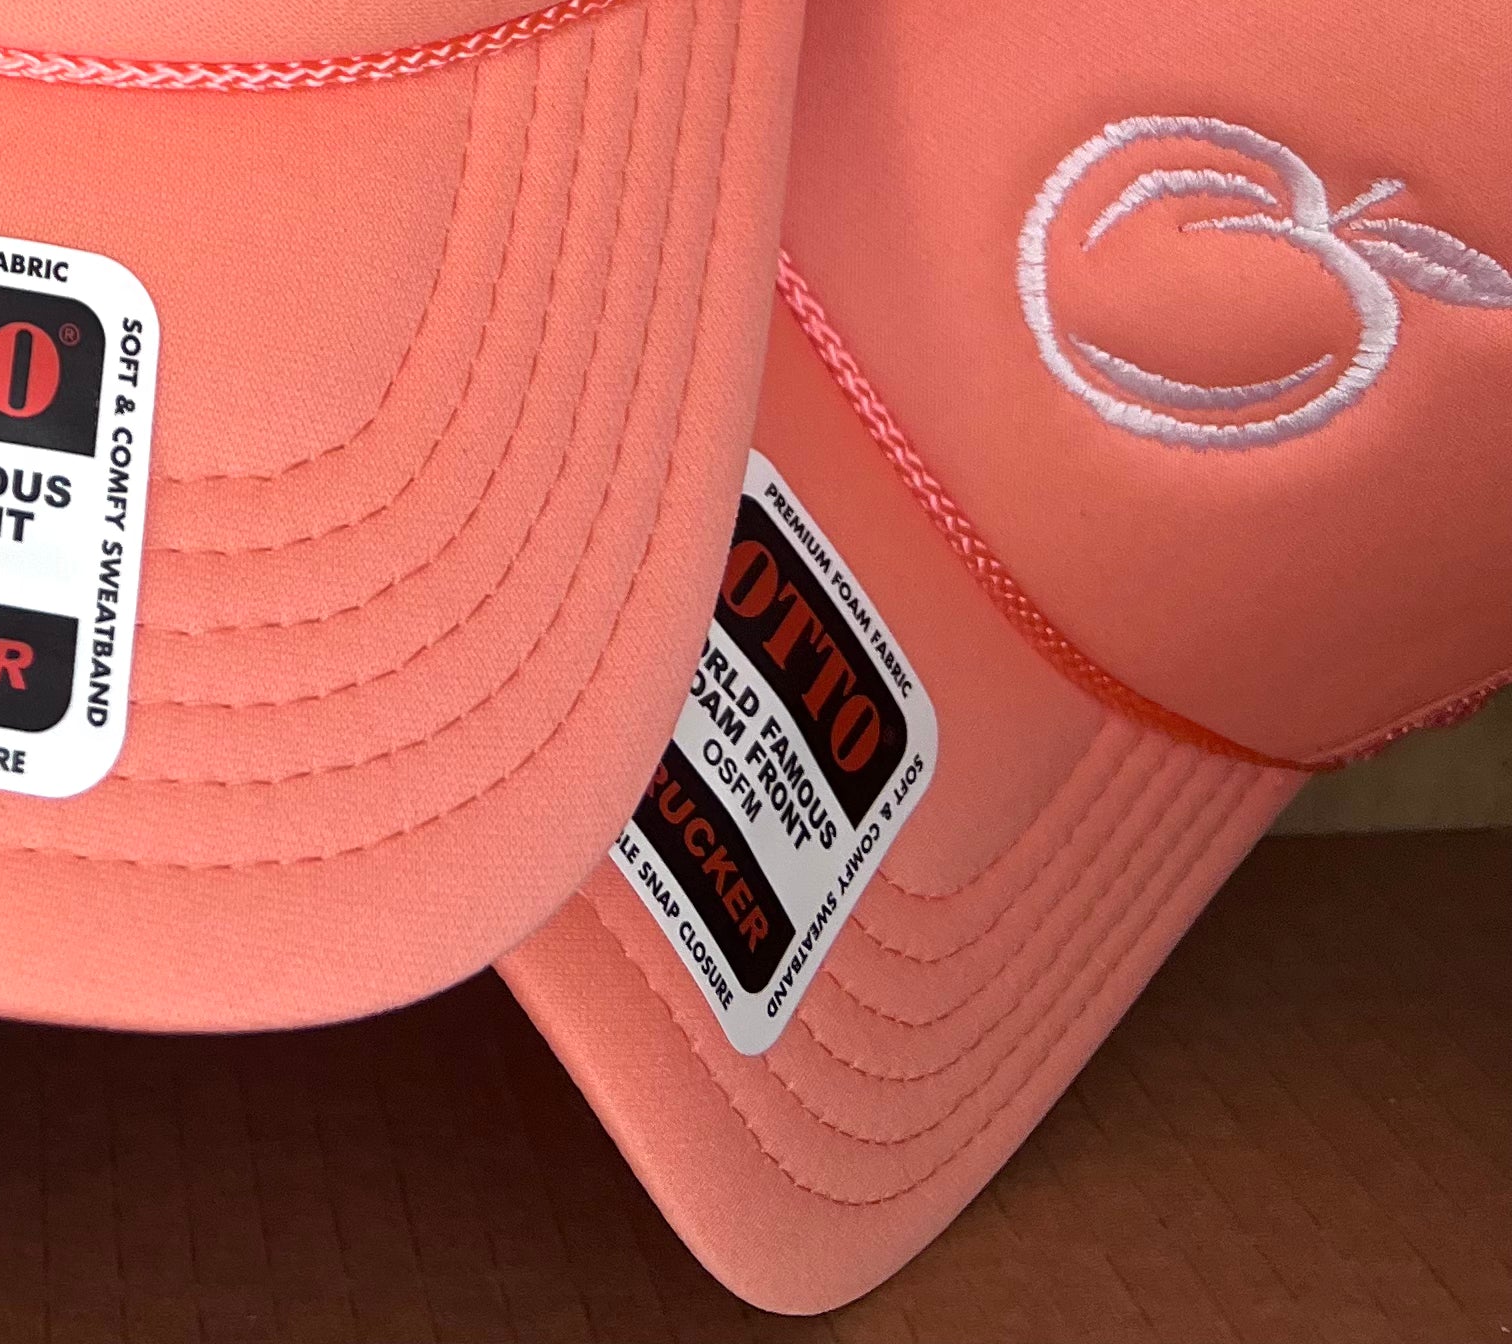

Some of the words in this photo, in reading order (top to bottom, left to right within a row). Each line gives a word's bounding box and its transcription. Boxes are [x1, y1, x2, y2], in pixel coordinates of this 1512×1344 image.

[115, 395, 136, 415] &
[116, 317, 143, 385] SOFT
[104, 426, 133, 532] COMFY
[88, 539, 123, 728] SWEATBAND
[764, 482, 832, 574] PREMIUM
[831, 571, 871, 633] FOAM
[870, 630, 912, 699] FABRIC
[721, 540, 880, 772] OTTO
[690, 669, 746, 746] OAM
[744, 740, 811, 850] FRONT
[701, 637, 760, 717] RLD
[760, 715, 837, 850] FAMOUS
[703, 738, 763, 823] OSFM
[893, 754, 923, 806] SOFT
[645, 761, 769, 953] UCKER
[838, 822, 880, 895] COMFY
[880, 802, 893, 820] &
[638, 861, 680, 919] SNAP
[679, 921, 734, 1011] CLOSURE
[767, 891, 838, 1017] SWEATBAND
